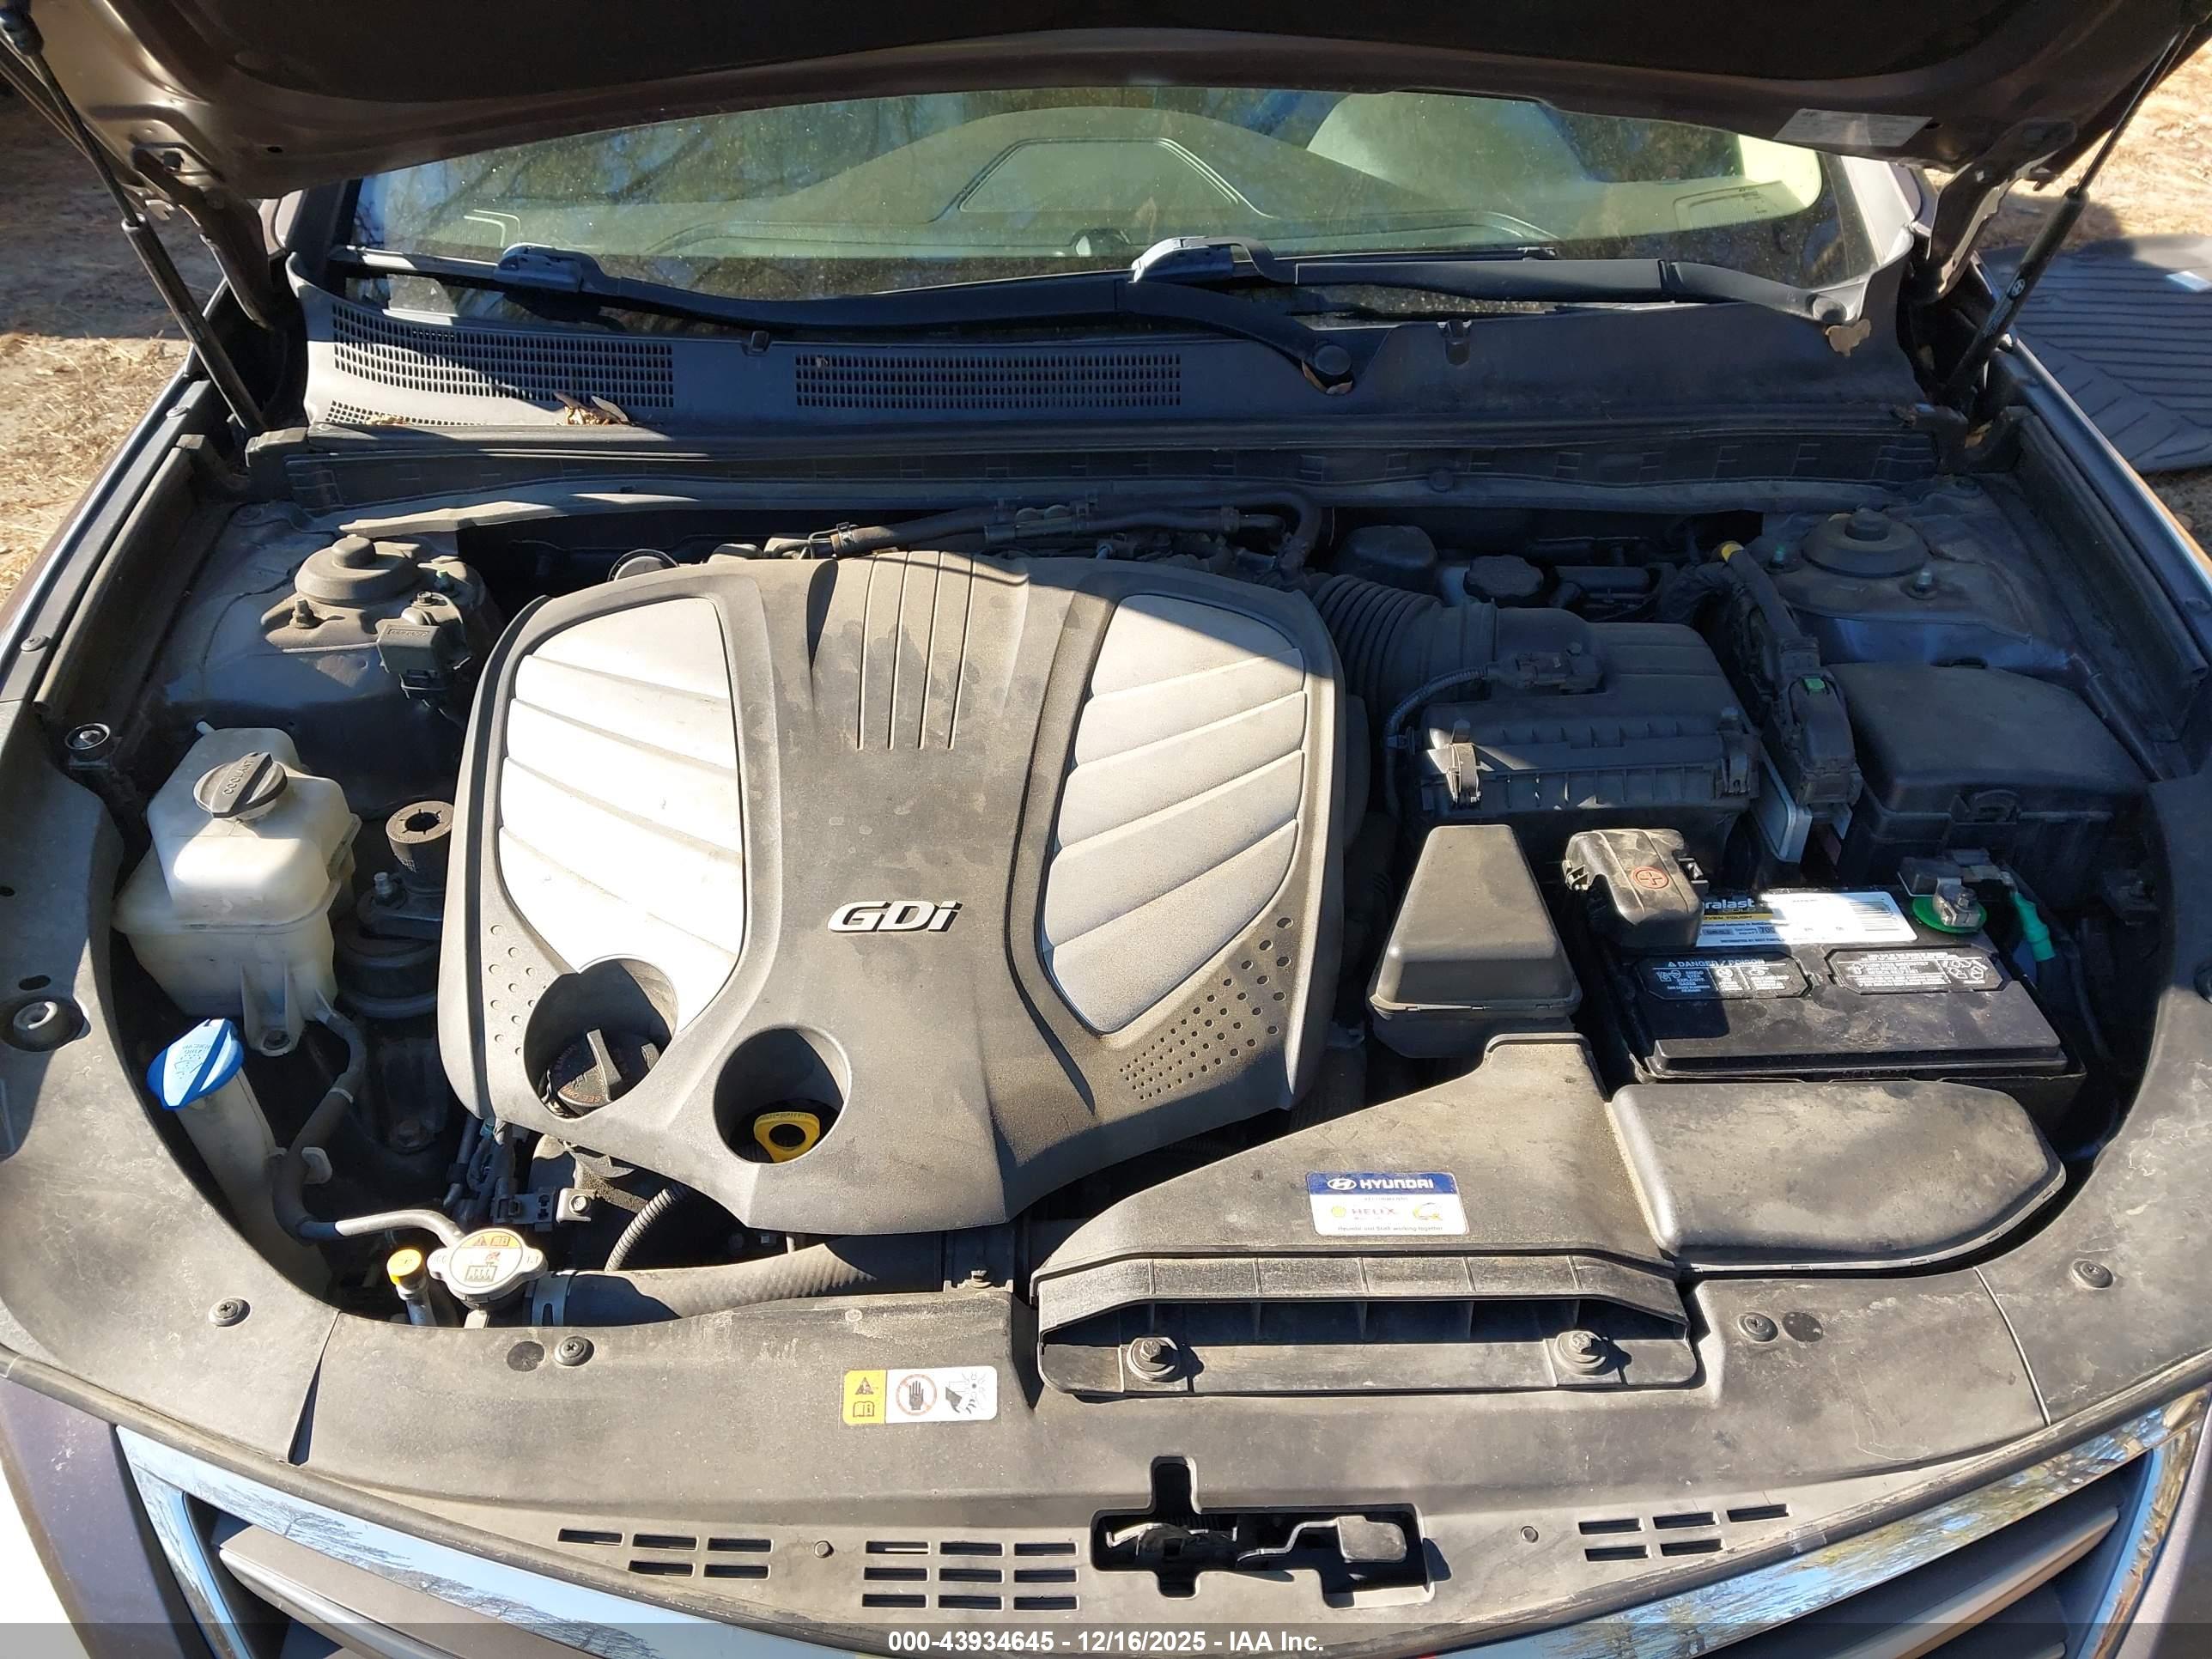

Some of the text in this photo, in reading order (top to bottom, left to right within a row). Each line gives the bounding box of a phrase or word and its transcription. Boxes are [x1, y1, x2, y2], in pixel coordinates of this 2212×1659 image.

[222, 759, 255, 796] COOLANT
[827, 900, 963, 933] GDi
[1359, 1178, 1435, 1189] HYUNDAI
